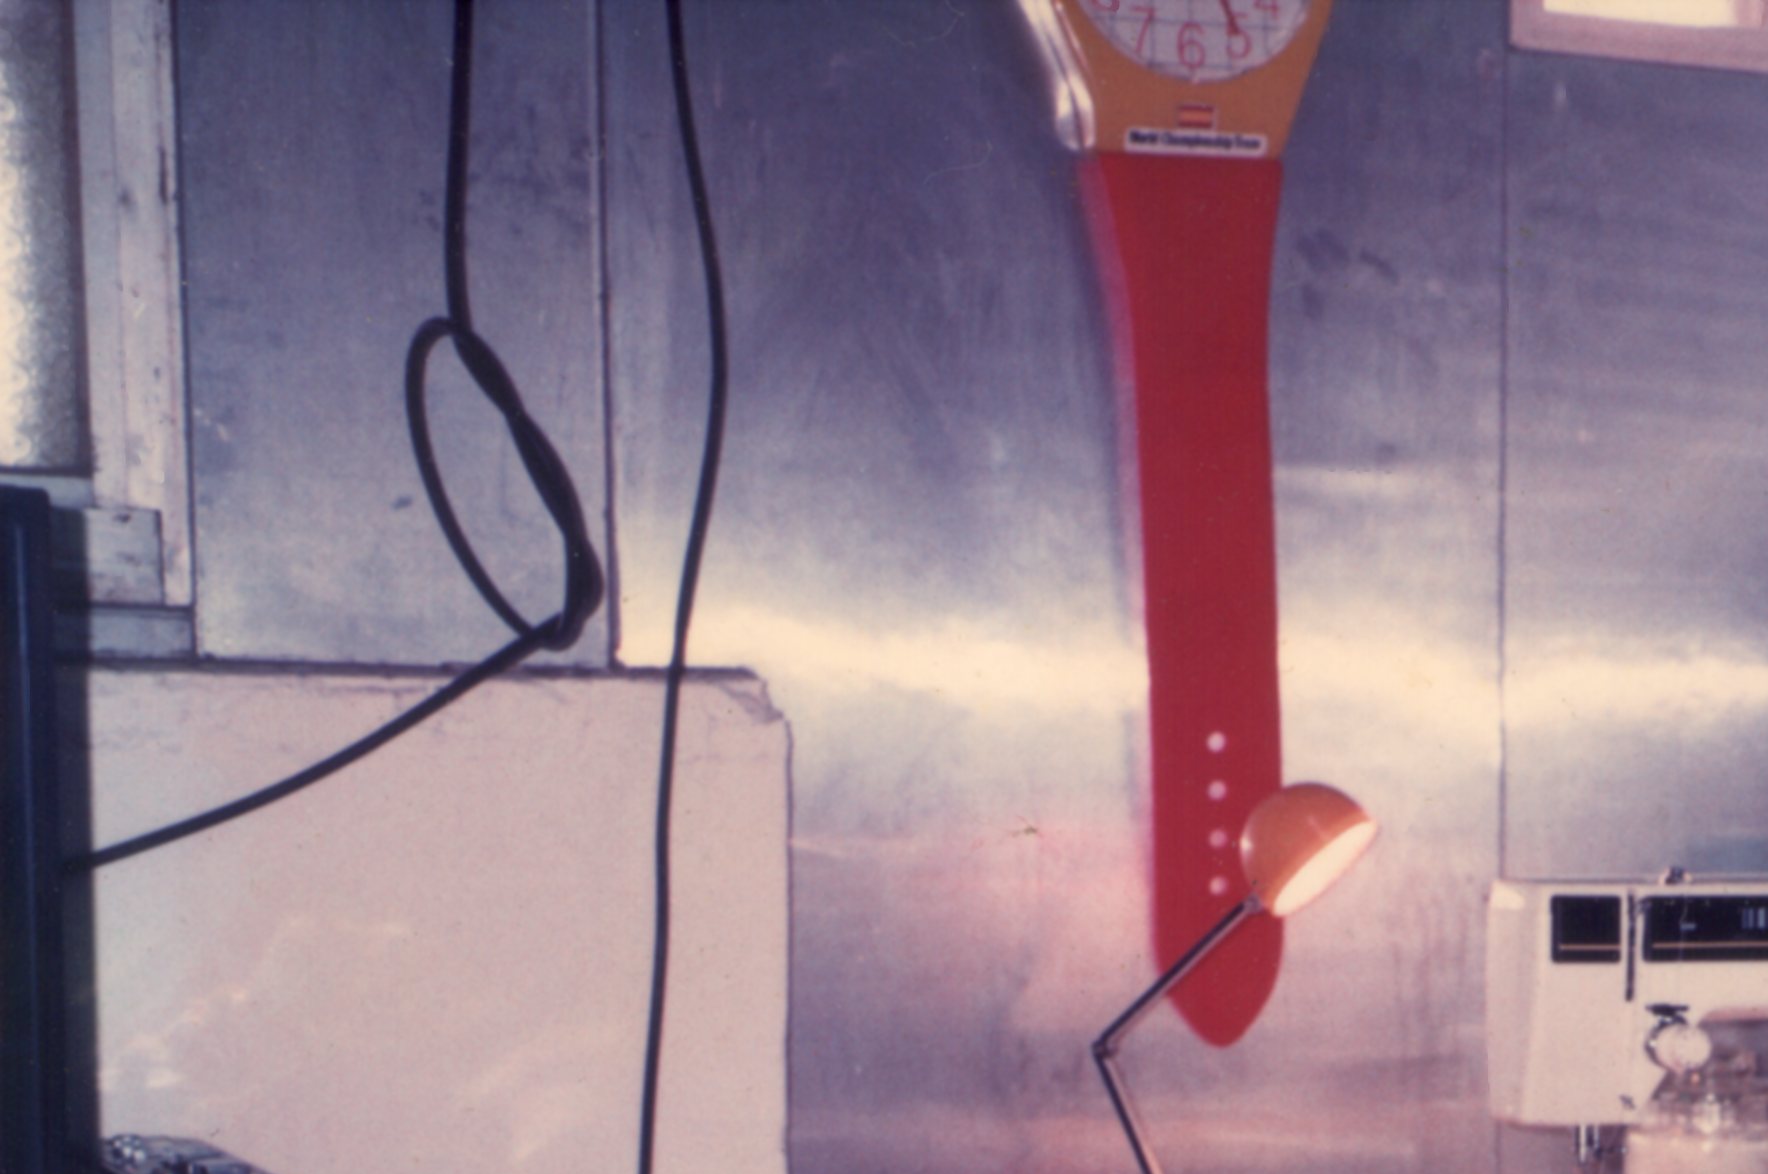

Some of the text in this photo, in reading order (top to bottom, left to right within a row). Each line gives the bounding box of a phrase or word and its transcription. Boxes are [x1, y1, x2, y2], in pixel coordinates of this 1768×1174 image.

[1131, 5, 1155, 54] 7
[1176, 21, 1205, 69] 6
[1226, 13, 1254, 59] 5
